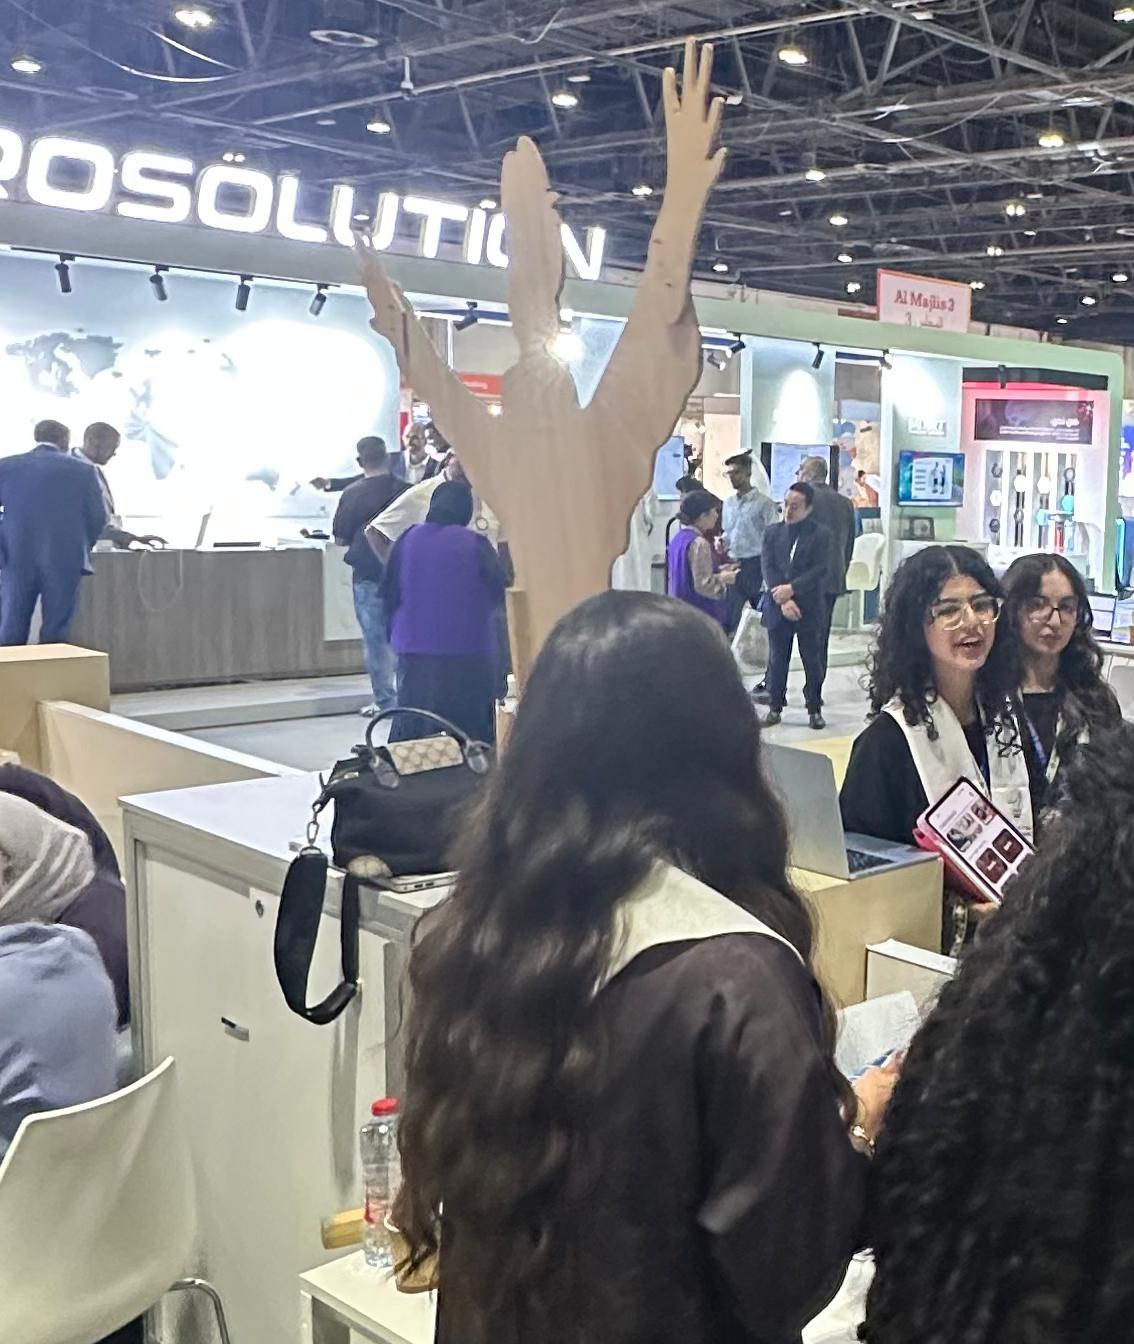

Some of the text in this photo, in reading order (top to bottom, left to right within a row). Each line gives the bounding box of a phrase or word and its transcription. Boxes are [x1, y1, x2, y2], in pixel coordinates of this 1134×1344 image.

[0, 127, 606, 281] OSOLUTIN
[894, 290, 908, 305] Al
[910, 293, 947, 312] Majlis
